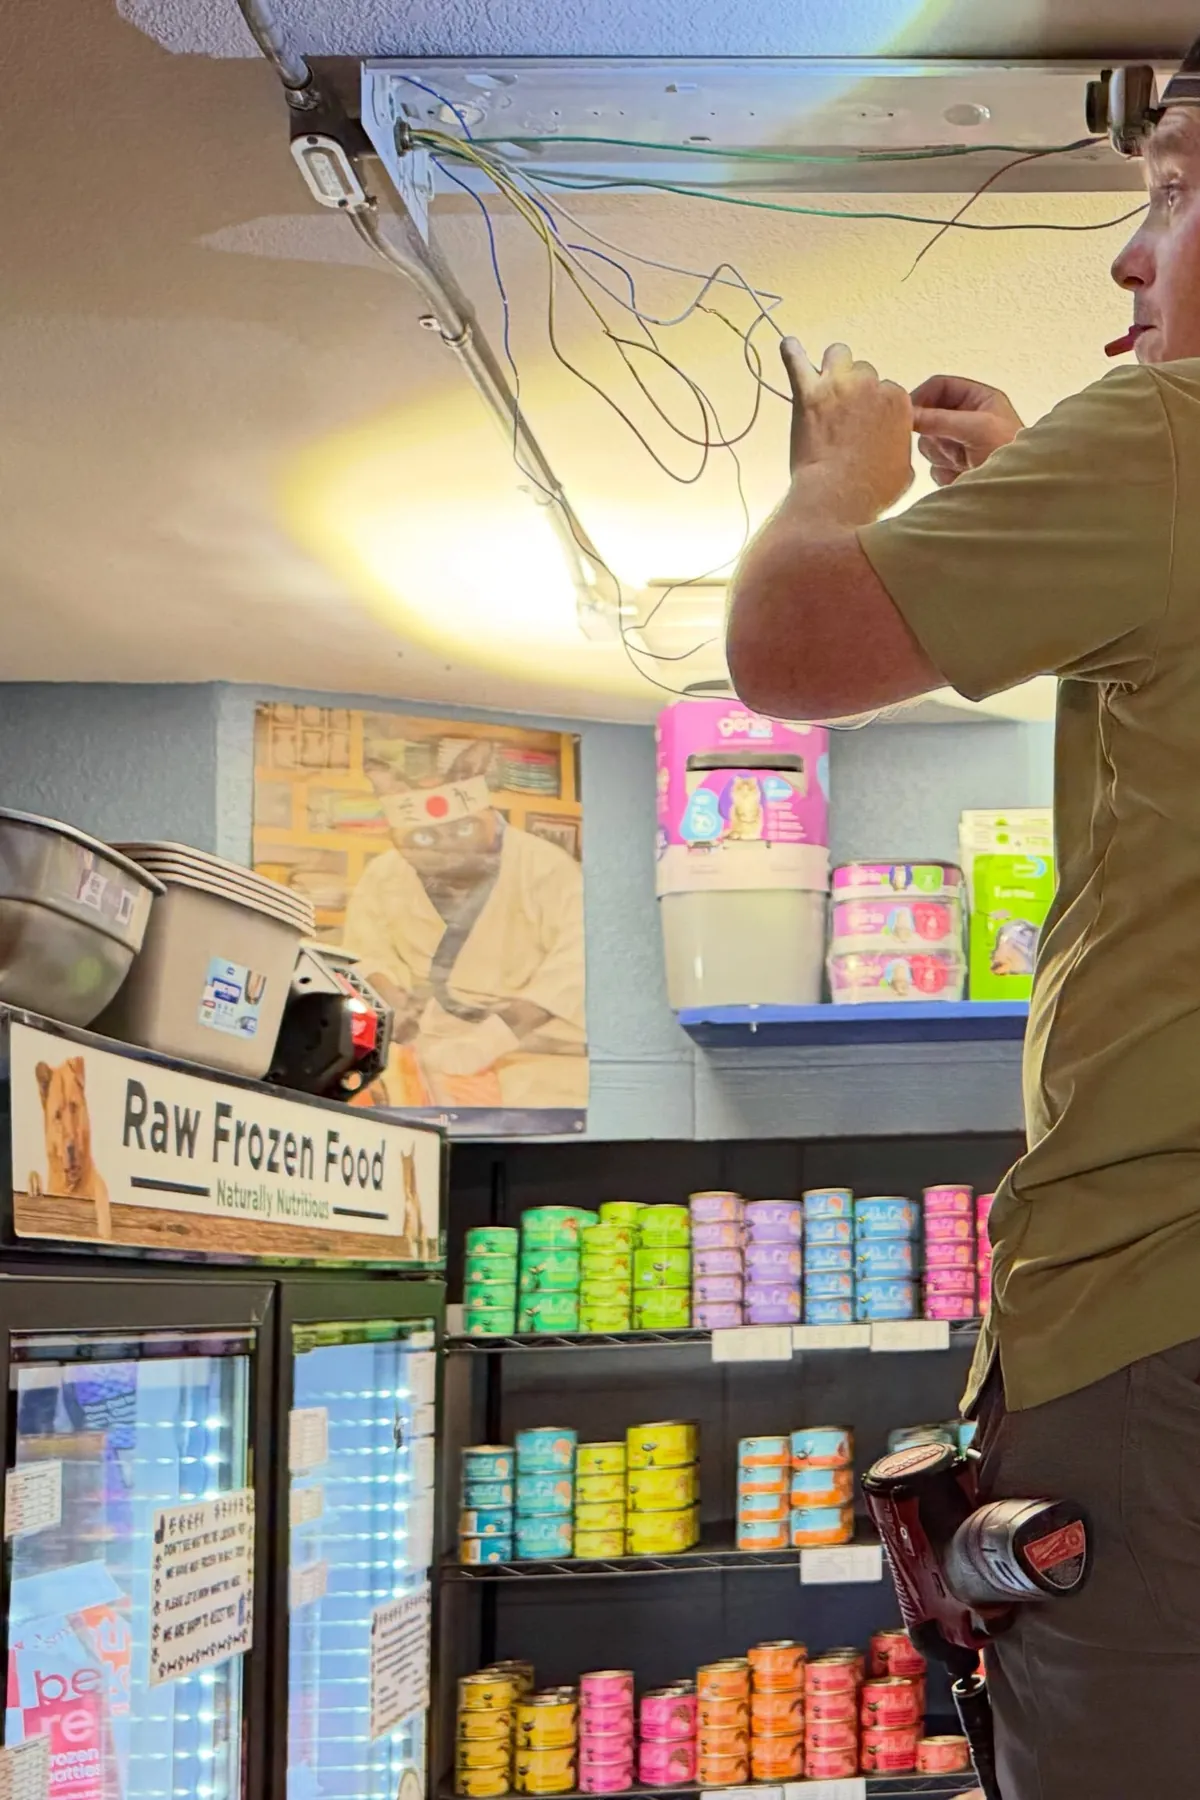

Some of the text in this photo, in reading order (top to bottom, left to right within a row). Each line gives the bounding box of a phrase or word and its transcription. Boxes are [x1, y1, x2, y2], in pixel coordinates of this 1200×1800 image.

[122, 1077, 387, 1191] Raw Frozen Food
[215, 1177, 330, 1221] Naturally Nutritious
[50, 1748, 99, 1767] rozen
